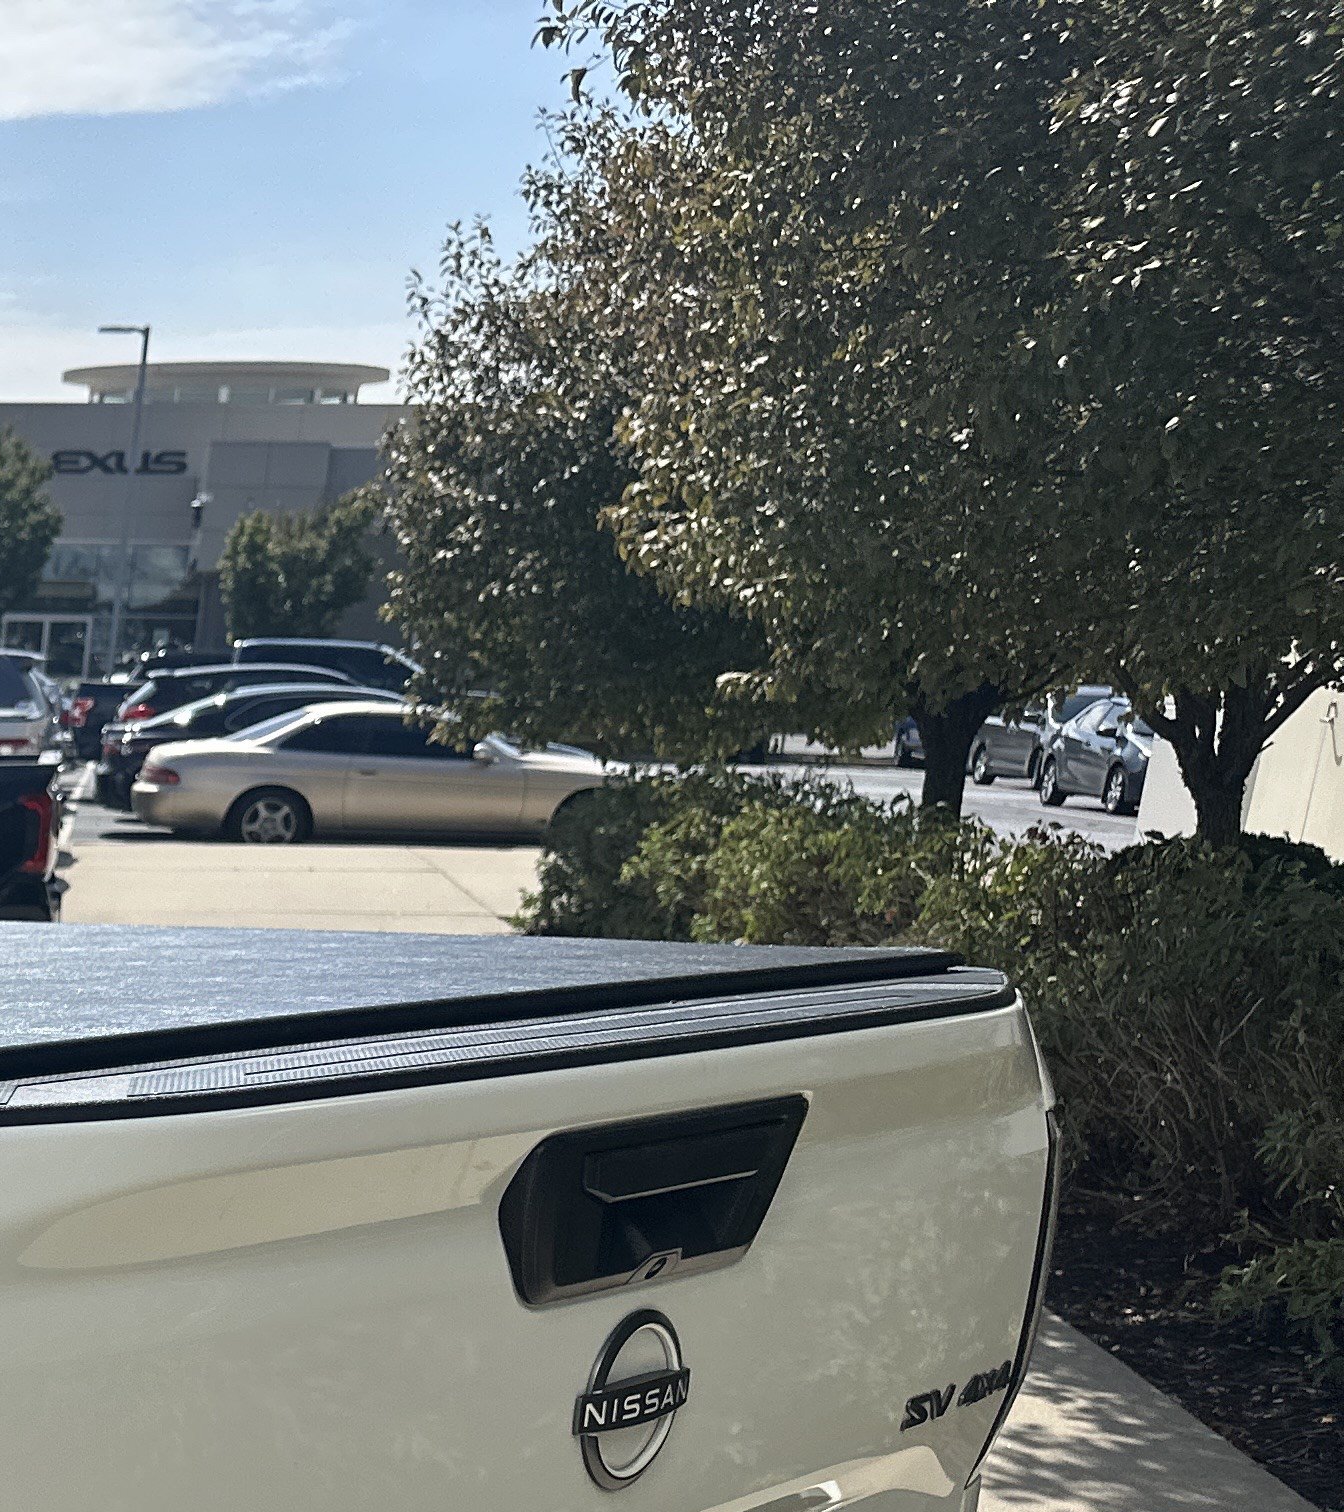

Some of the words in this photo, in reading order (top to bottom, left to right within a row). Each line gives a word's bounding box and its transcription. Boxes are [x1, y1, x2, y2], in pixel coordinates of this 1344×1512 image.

[52, 448, 189, 476] EXUS
[582, 1379, 688, 1428] NISSAN
[899, 1382, 957, 1433] SV
